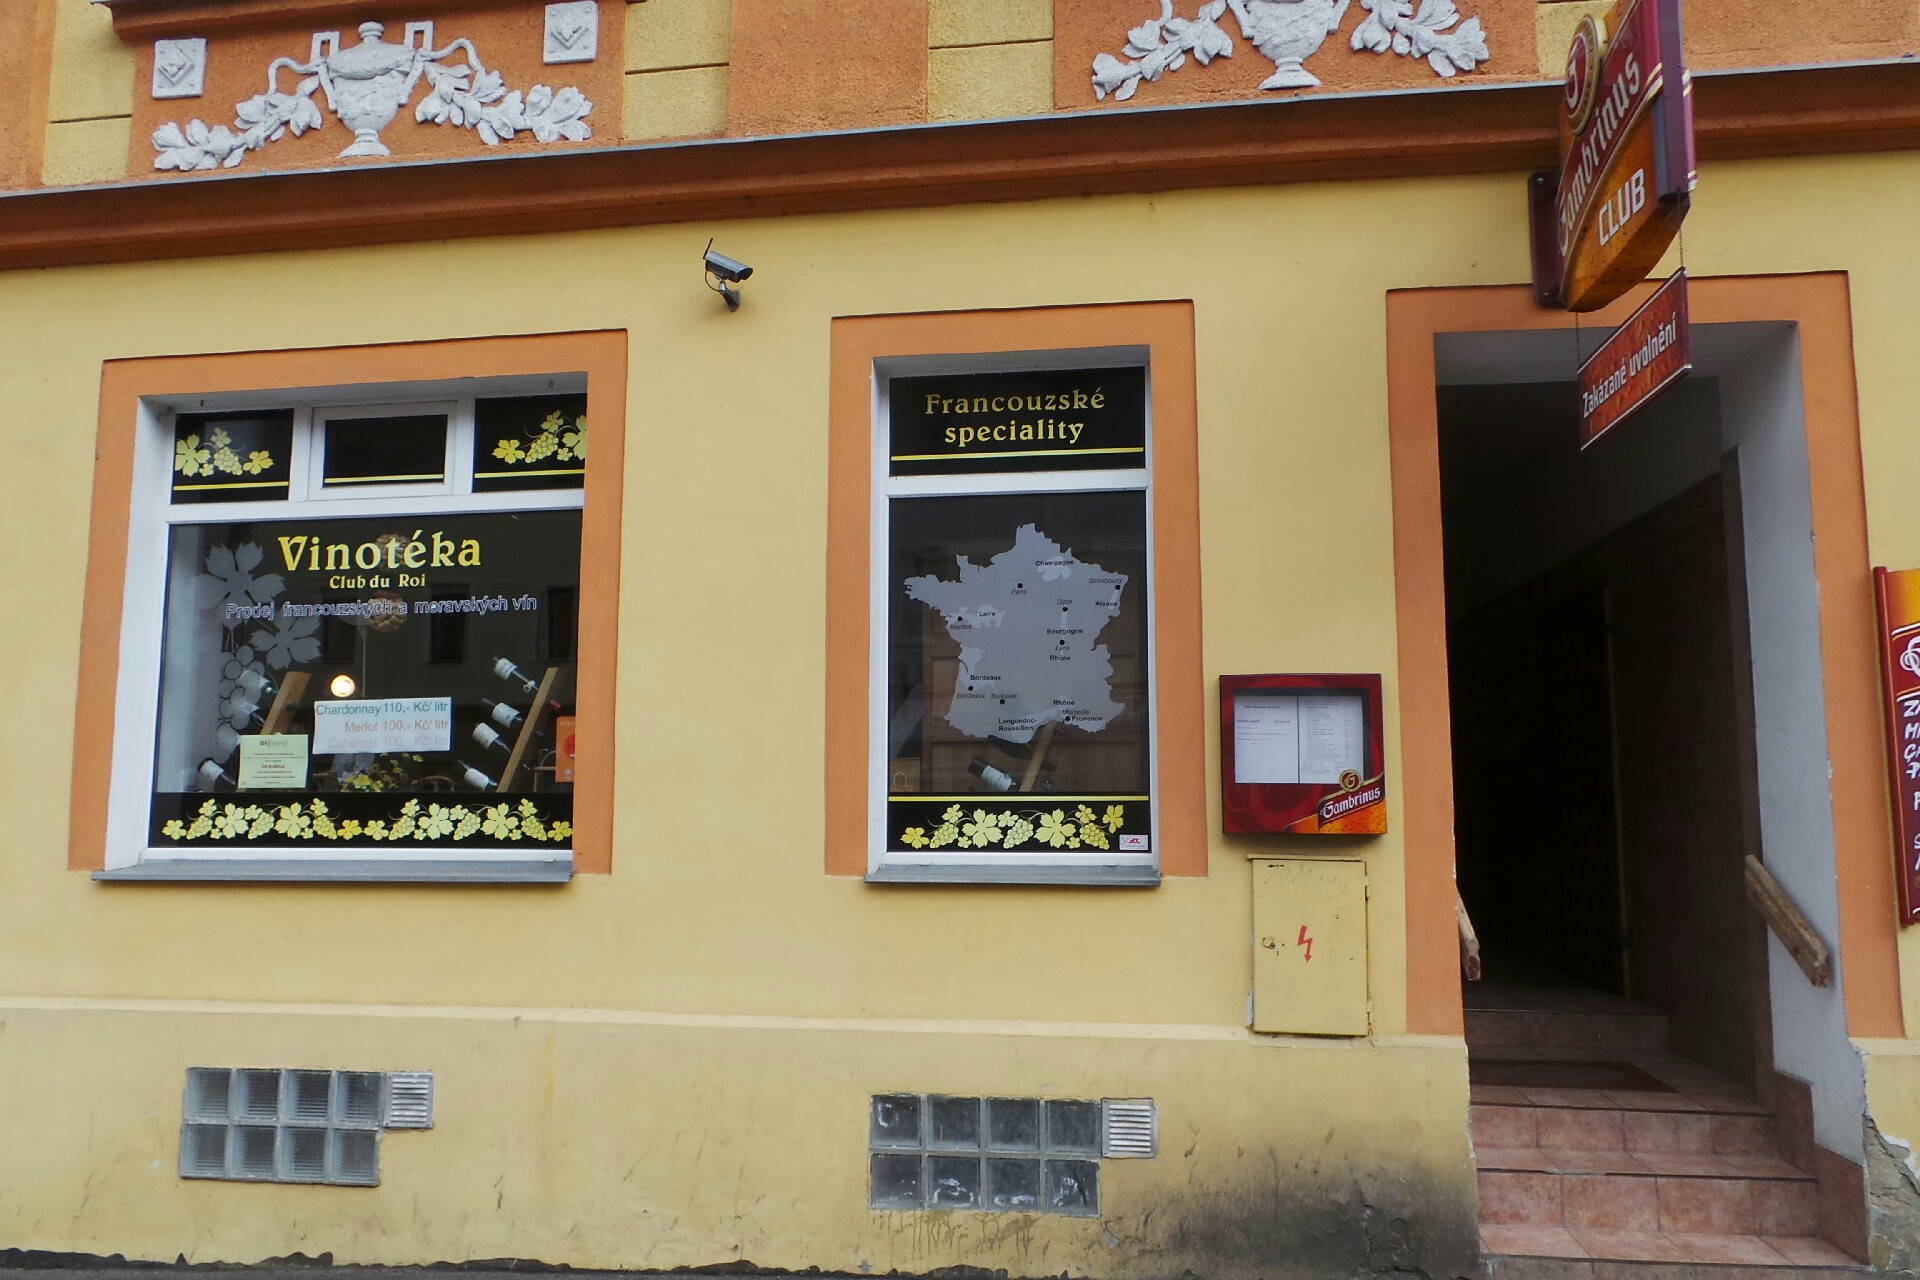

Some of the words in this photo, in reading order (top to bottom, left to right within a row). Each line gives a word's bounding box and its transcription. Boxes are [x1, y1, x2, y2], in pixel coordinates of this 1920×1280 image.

[1557, 52, 1641, 257] Gambrinus
[1598, 168, 1646, 246] CLUB
[1582, 358, 1628, 419] Zakázané
[1629, 312, 1677, 378] uvolnění
[925, 386, 1106, 415] Francouzské
[944, 418, 1084, 448] speciality
[277, 529, 482, 572] Vinotéka
[1035, 559, 1074, 568] Champagne
[329, 574, 366, 589] Club
[369, 574, 390, 588] du
[398, 573, 427, 588] Roi
[225, 602, 275, 621] Prodej
[282, 598, 392, 619] francouzských
[398, 602, 408, 614] a
[414, 595, 508, 616] moravských
[511, 593, 538, 611] vín
[1056, 598, 1073, 606] Dijon
[1046, 628, 1083, 636] Bourgogne
[315, 704, 382, 717] Chardonnay
[434, 701, 448, 711] litr
[998, 717, 1037, 726] Languedoc-
[344, 721, 379, 733] Merlot
[435, 719, 449, 730] litr
[1319, 787, 1381, 819] Gambrinus
